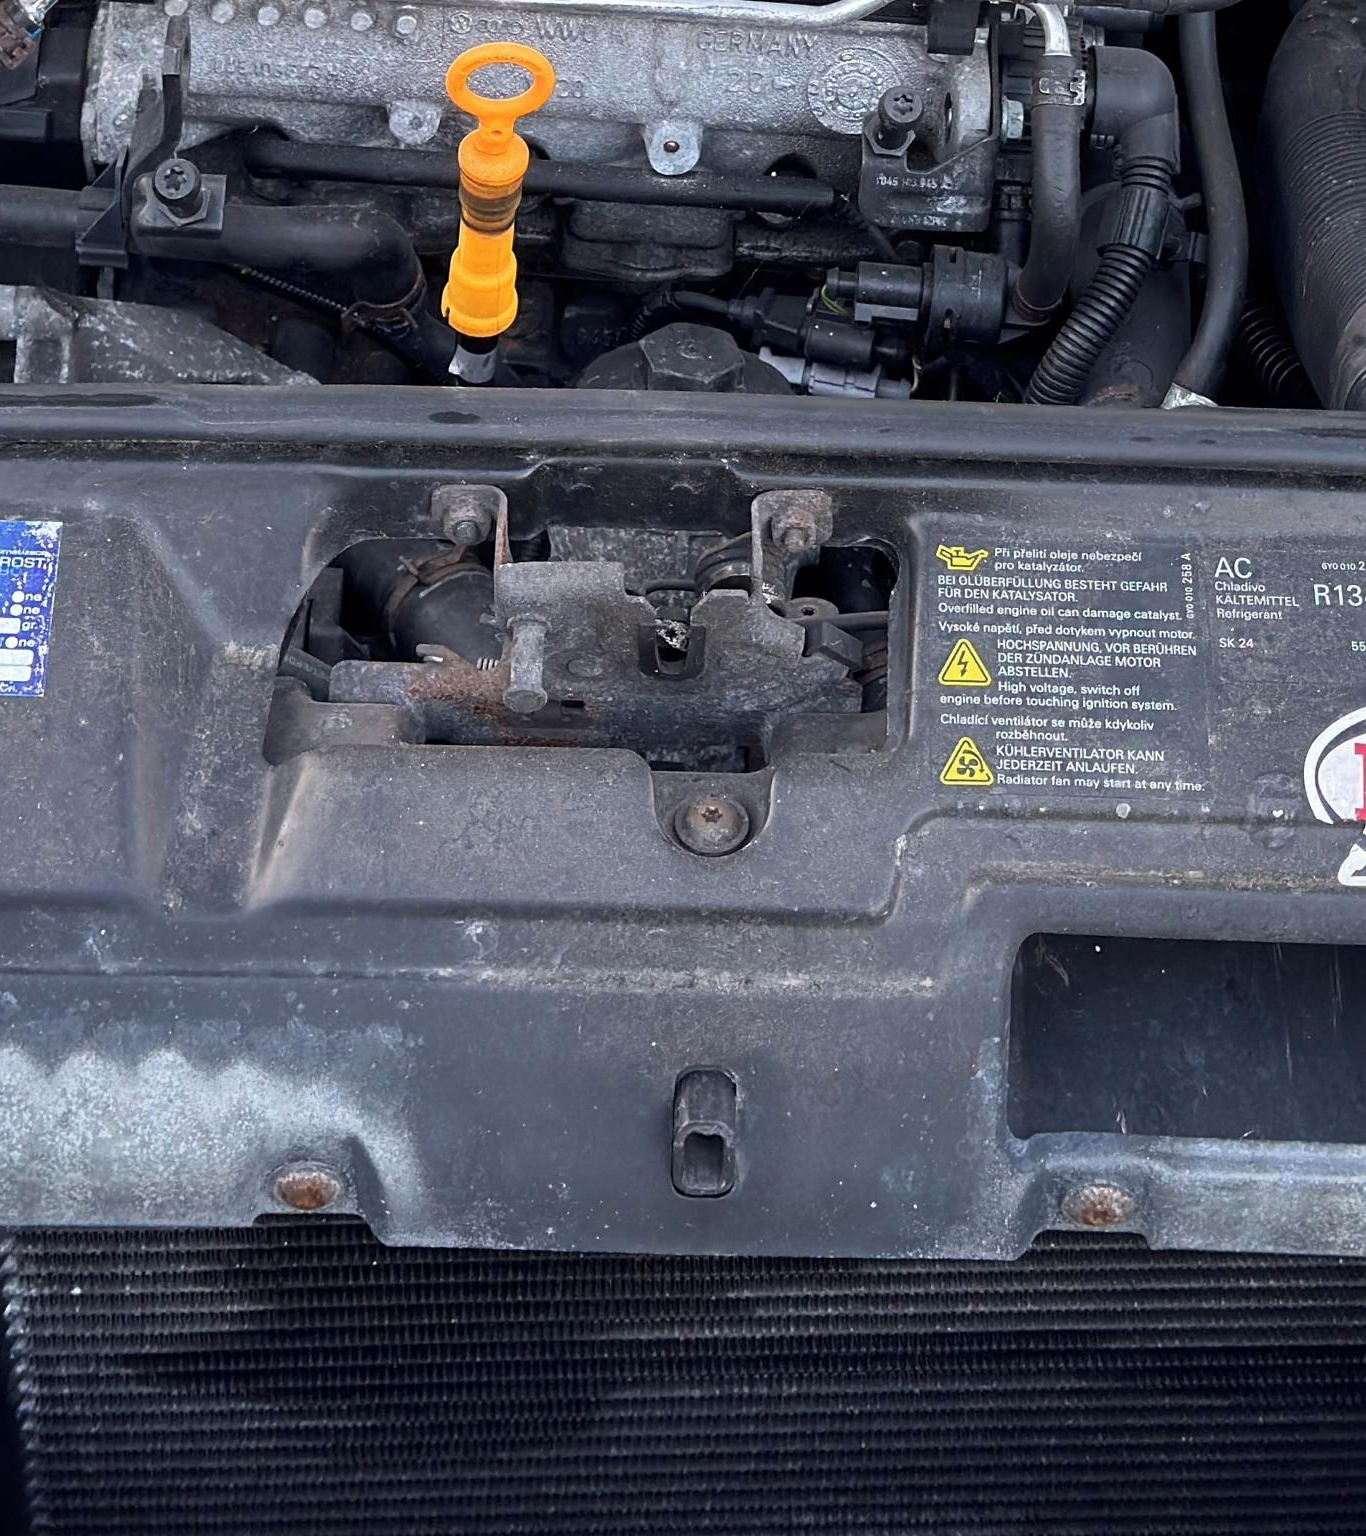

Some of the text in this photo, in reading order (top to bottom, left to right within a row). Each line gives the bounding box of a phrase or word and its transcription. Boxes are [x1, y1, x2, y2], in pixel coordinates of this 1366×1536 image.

[697, 27, 819, 57] GERMANY
[995, 547, 1142, 562] Při přelití oleje nebezpečí
[1181, 553, 1191, 561] A
[995, 561, 1085, 573] pro katalyzátor.
[1181, 564, 1193, 584] 258
[1214, 556, 1253, 579] AC
[1340, 563, 1356, 571] 010
[938, 575, 956, 585] BEI
[1064, 579, 1118, 591] BESTEHT
[1120, 581, 1168, 592] GEFAHR
[1214, 581, 1266, 592] Chladivo
[25, 593, 42, 601] ne
[938, 586, 1078, 602] FÜR DEN KATALYSATOR.
[1184, 586, 1193, 602] 010
[1215, 593, 1300, 607] KÄLTEMITTEL
[23, 607, 40, 615] ne
[938, 603, 1182, 622] Overfilled engine oil can damage catalyst.
[1216, 608, 1283, 621] Refrigerant
[938, 620, 980, 633] Vysoké
[1026, 624, 1052, 635] před
[1055, 624, 1105, 637] dotykem
[1108, 627, 1156, 639] vypnout
[1159, 629, 1195, 640] motor.
[19, 639, 36, 647] ne
[1105, 642, 1130, 653] VOR
[1133, 642, 1196, 656] BERÜHREN
[1219, 637, 1254, 648] SK 24
[998, 651, 1161, 668] DER ZÜNDANLAGE MOTOR
[998, 666, 1072, 678] ABSTELLEN.
[998, 681, 1026, 694] High
[1080, 684, 1121, 695] switch
[1123, 685, 1141, 696] off
[939, 693, 1177, 712] engine before touching ignition system.
[940, 712, 1154, 731] Chladící ventilátor se může kdykoliv
[995, 729, 1068, 741] rozběhnout.
[996, 743, 1165, 762] KÜHLERVENTILATOR KANN
[996, 758, 1139, 774] JEDERZEIT ANLAUFEN.
[997, 773, 1048, 785] Radiator
[1051, 775, 1071, 786] fan
[1074, 778, 1100, 789] may
[1103, 778, 1131, 788] start
[1134, 779, 1147, 789] at
[1149, 781, 1172, 791] any
